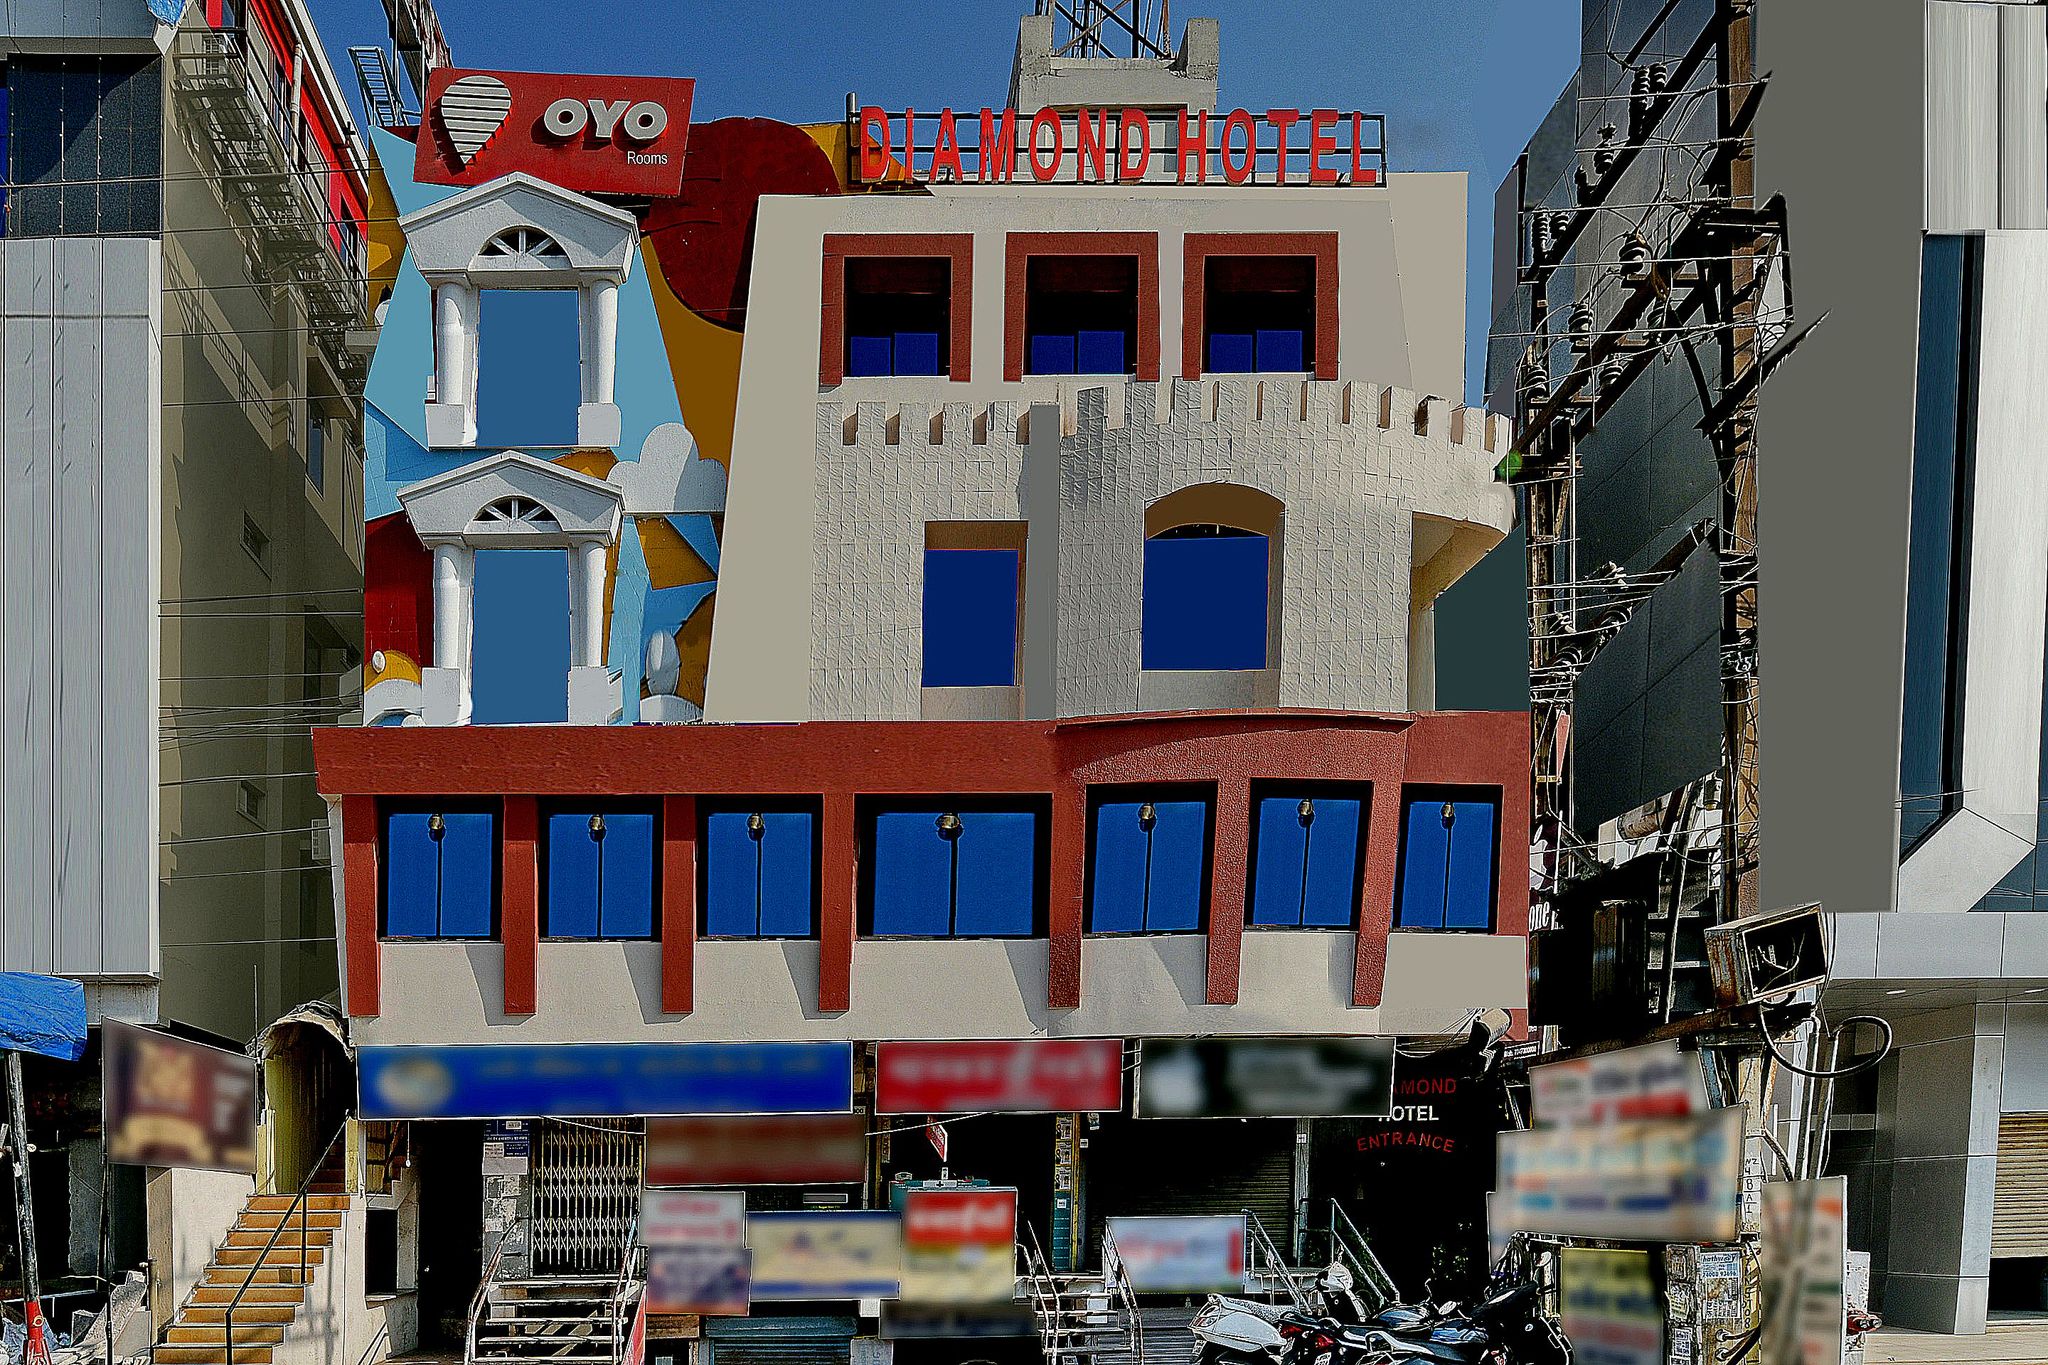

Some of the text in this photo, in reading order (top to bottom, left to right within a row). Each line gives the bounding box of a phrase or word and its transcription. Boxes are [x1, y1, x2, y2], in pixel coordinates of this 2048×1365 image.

[543, 98, 669, 140] OYO
[626, 150, 668, 165] Rooms
[860, 107, 1376, 186] DIAMOND HOTEL
[1379, 1105, 1440, 1121] OTEL
[1356, 1131, 1456, 1153] ENTRANCE
